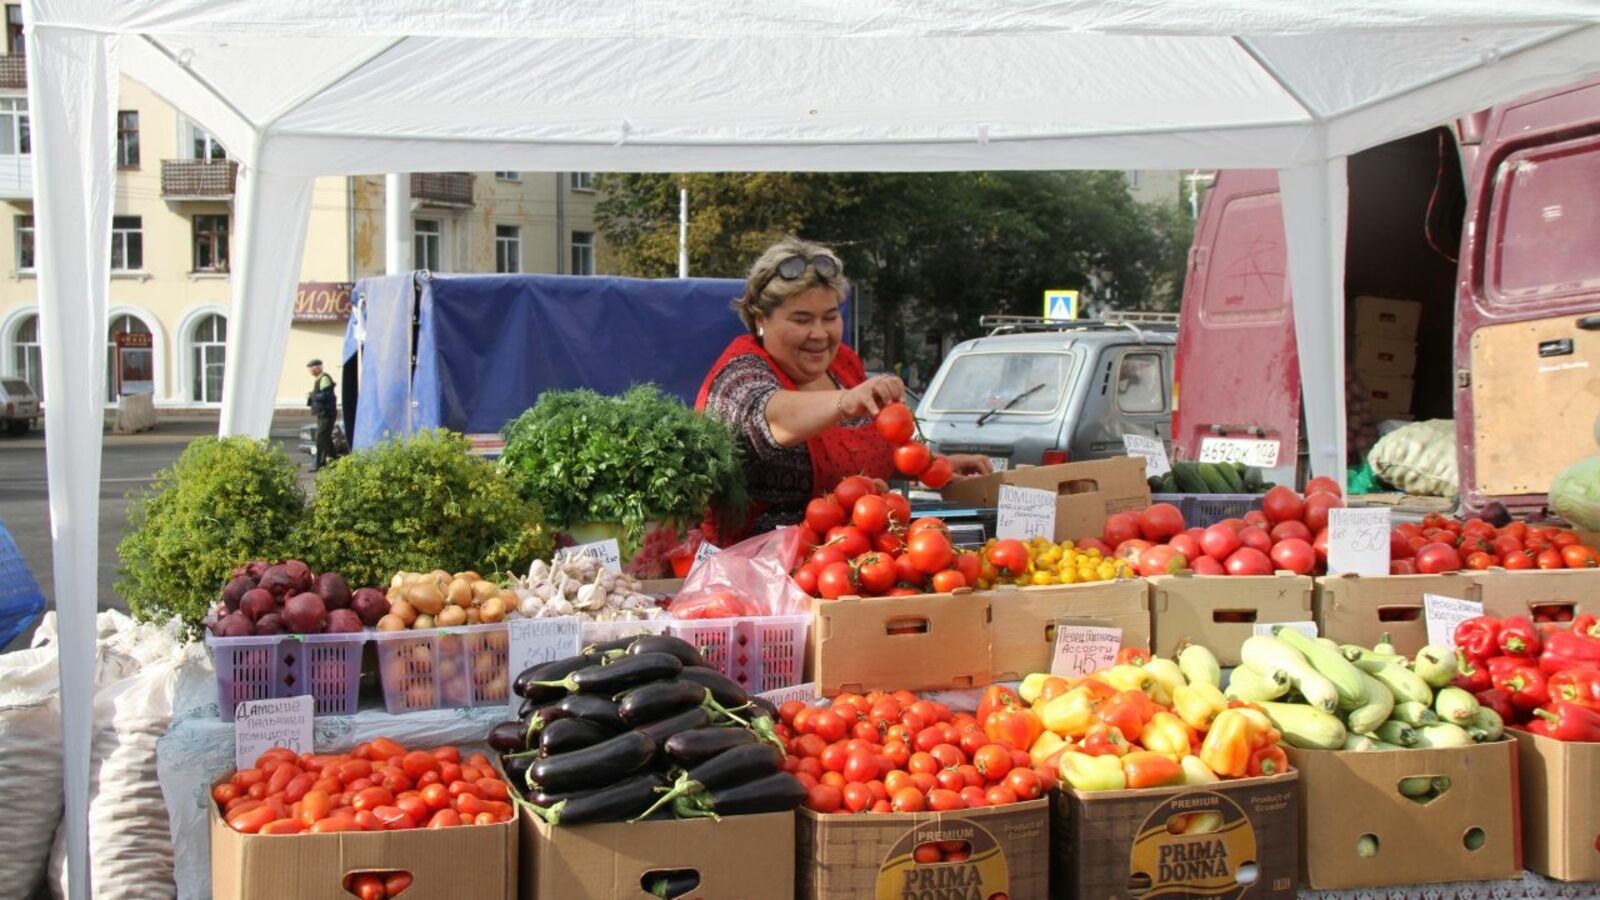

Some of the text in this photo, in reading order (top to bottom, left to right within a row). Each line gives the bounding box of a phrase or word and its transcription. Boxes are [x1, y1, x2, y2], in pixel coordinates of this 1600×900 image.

[1171, 796, 1219, 809] PREMIUM
[918, 829, 973, 841] PREMIUM
[1158, 839, 1228, 864] PRIMA
[902, 865, 983, 891] PRIMA
[1158, 859, 1229, 884] DONNA
